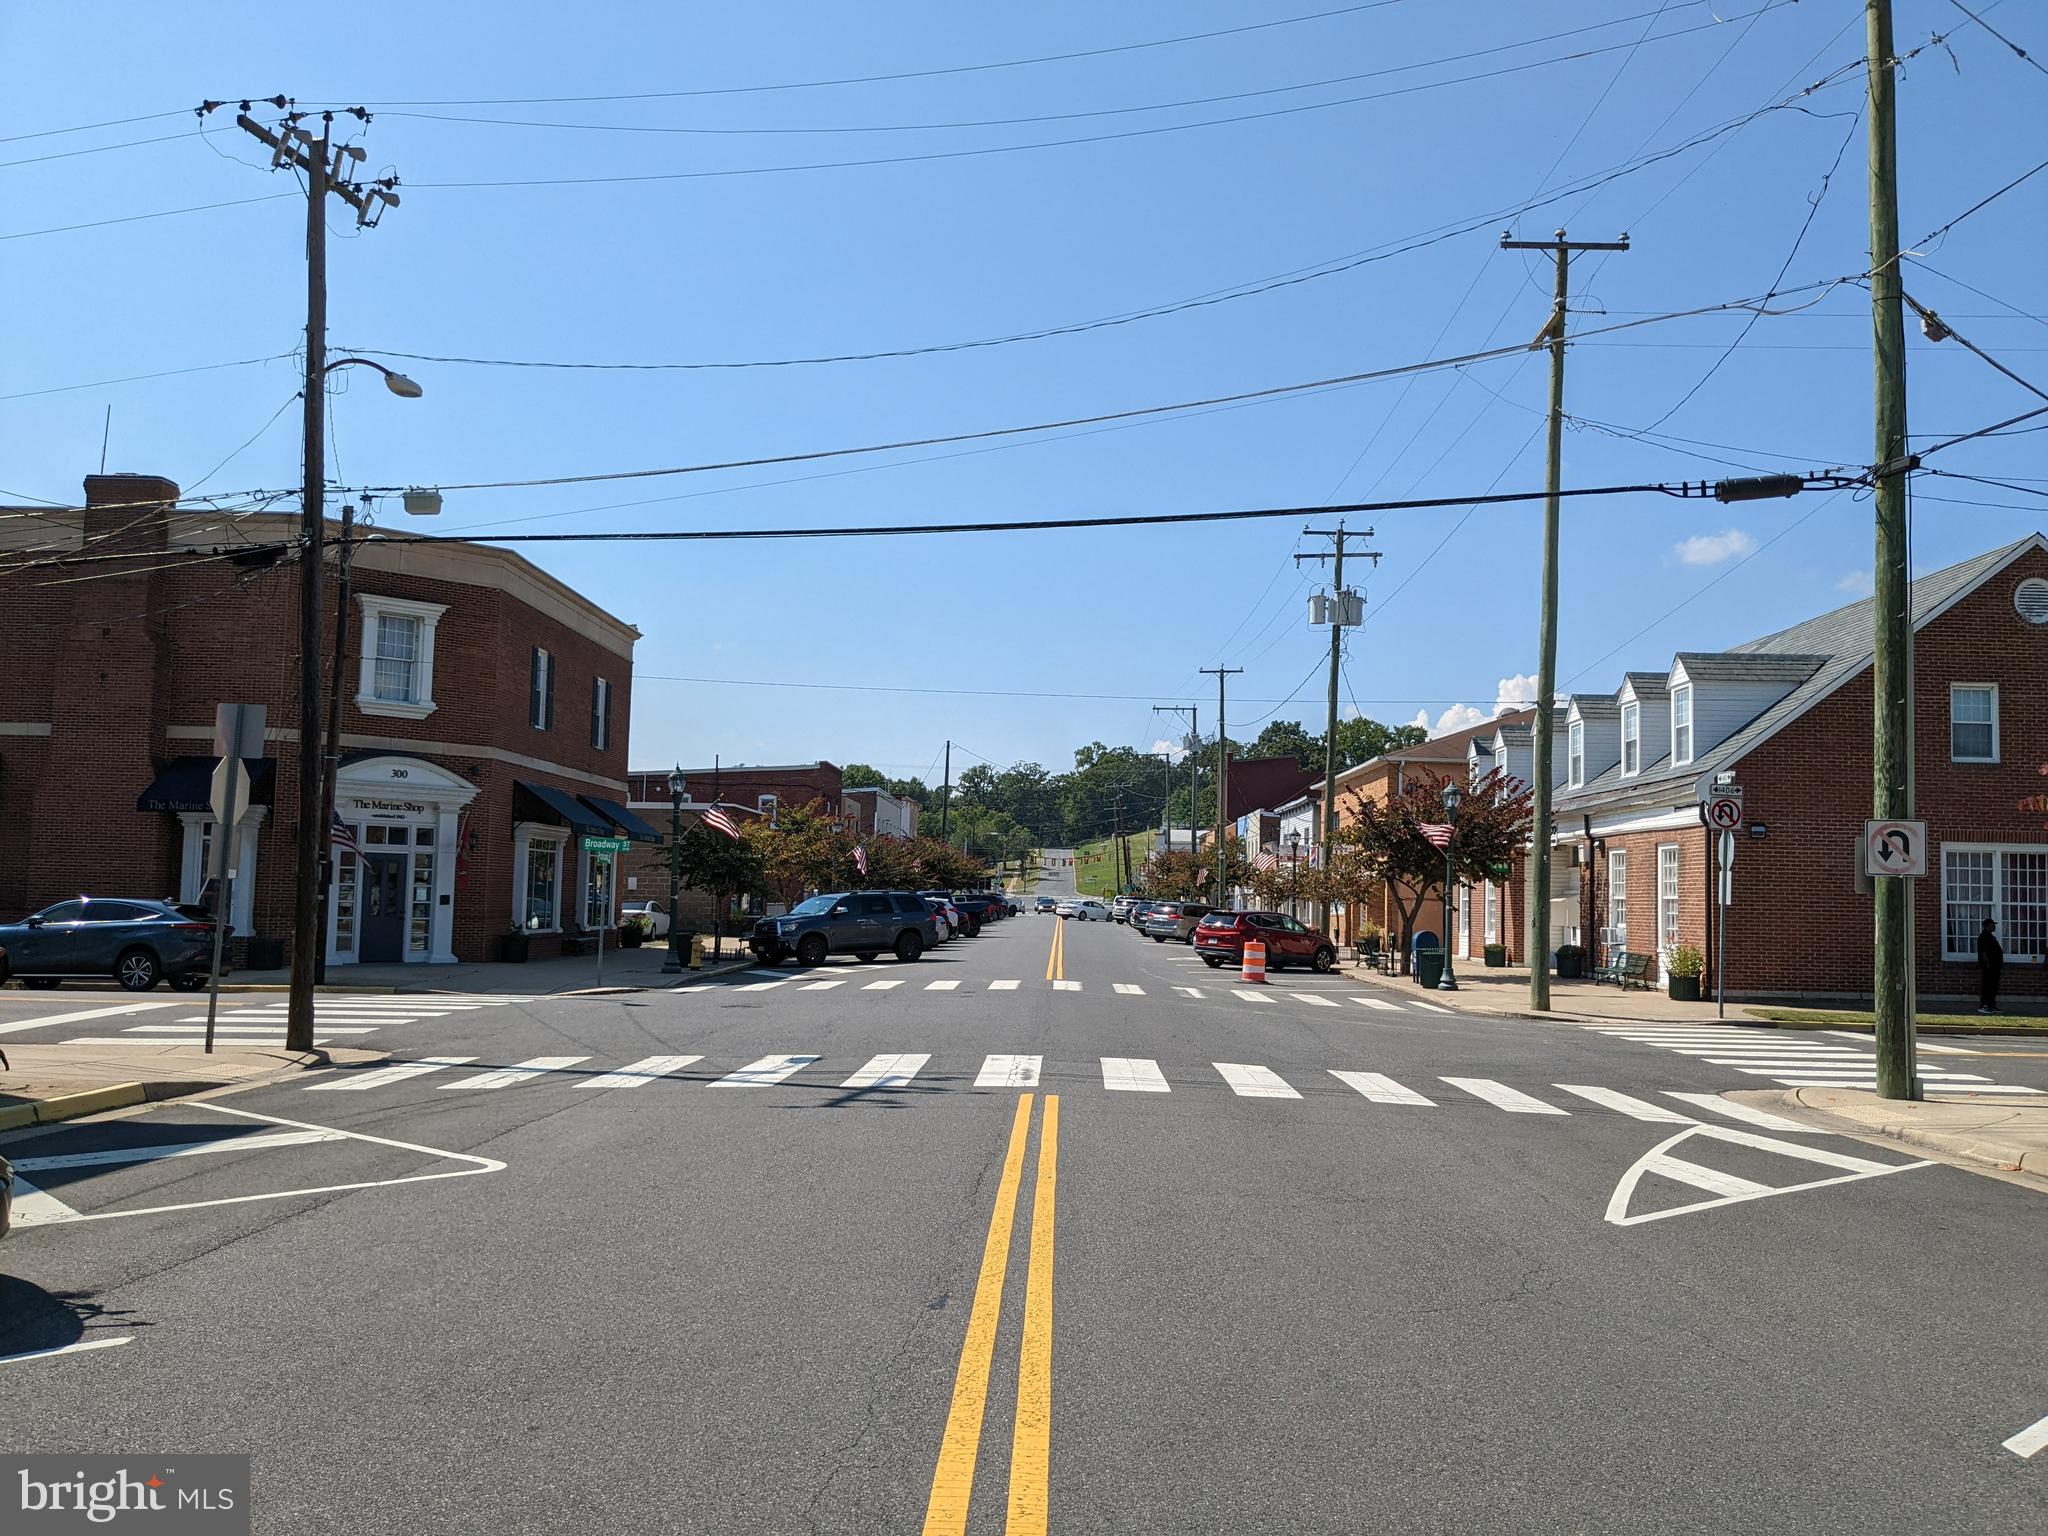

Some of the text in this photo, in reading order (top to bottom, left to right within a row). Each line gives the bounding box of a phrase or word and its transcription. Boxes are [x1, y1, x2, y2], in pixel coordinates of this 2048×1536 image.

[391, 769, 408, 779] 300
[1718, 786, 1735, 794] 1406
[148, 799, 165, 810] The
[169, 800, 204, 811] Marine
[353, 799, 424, 814] The Marine Shop
[585, 838, 619, 851] Broadway
